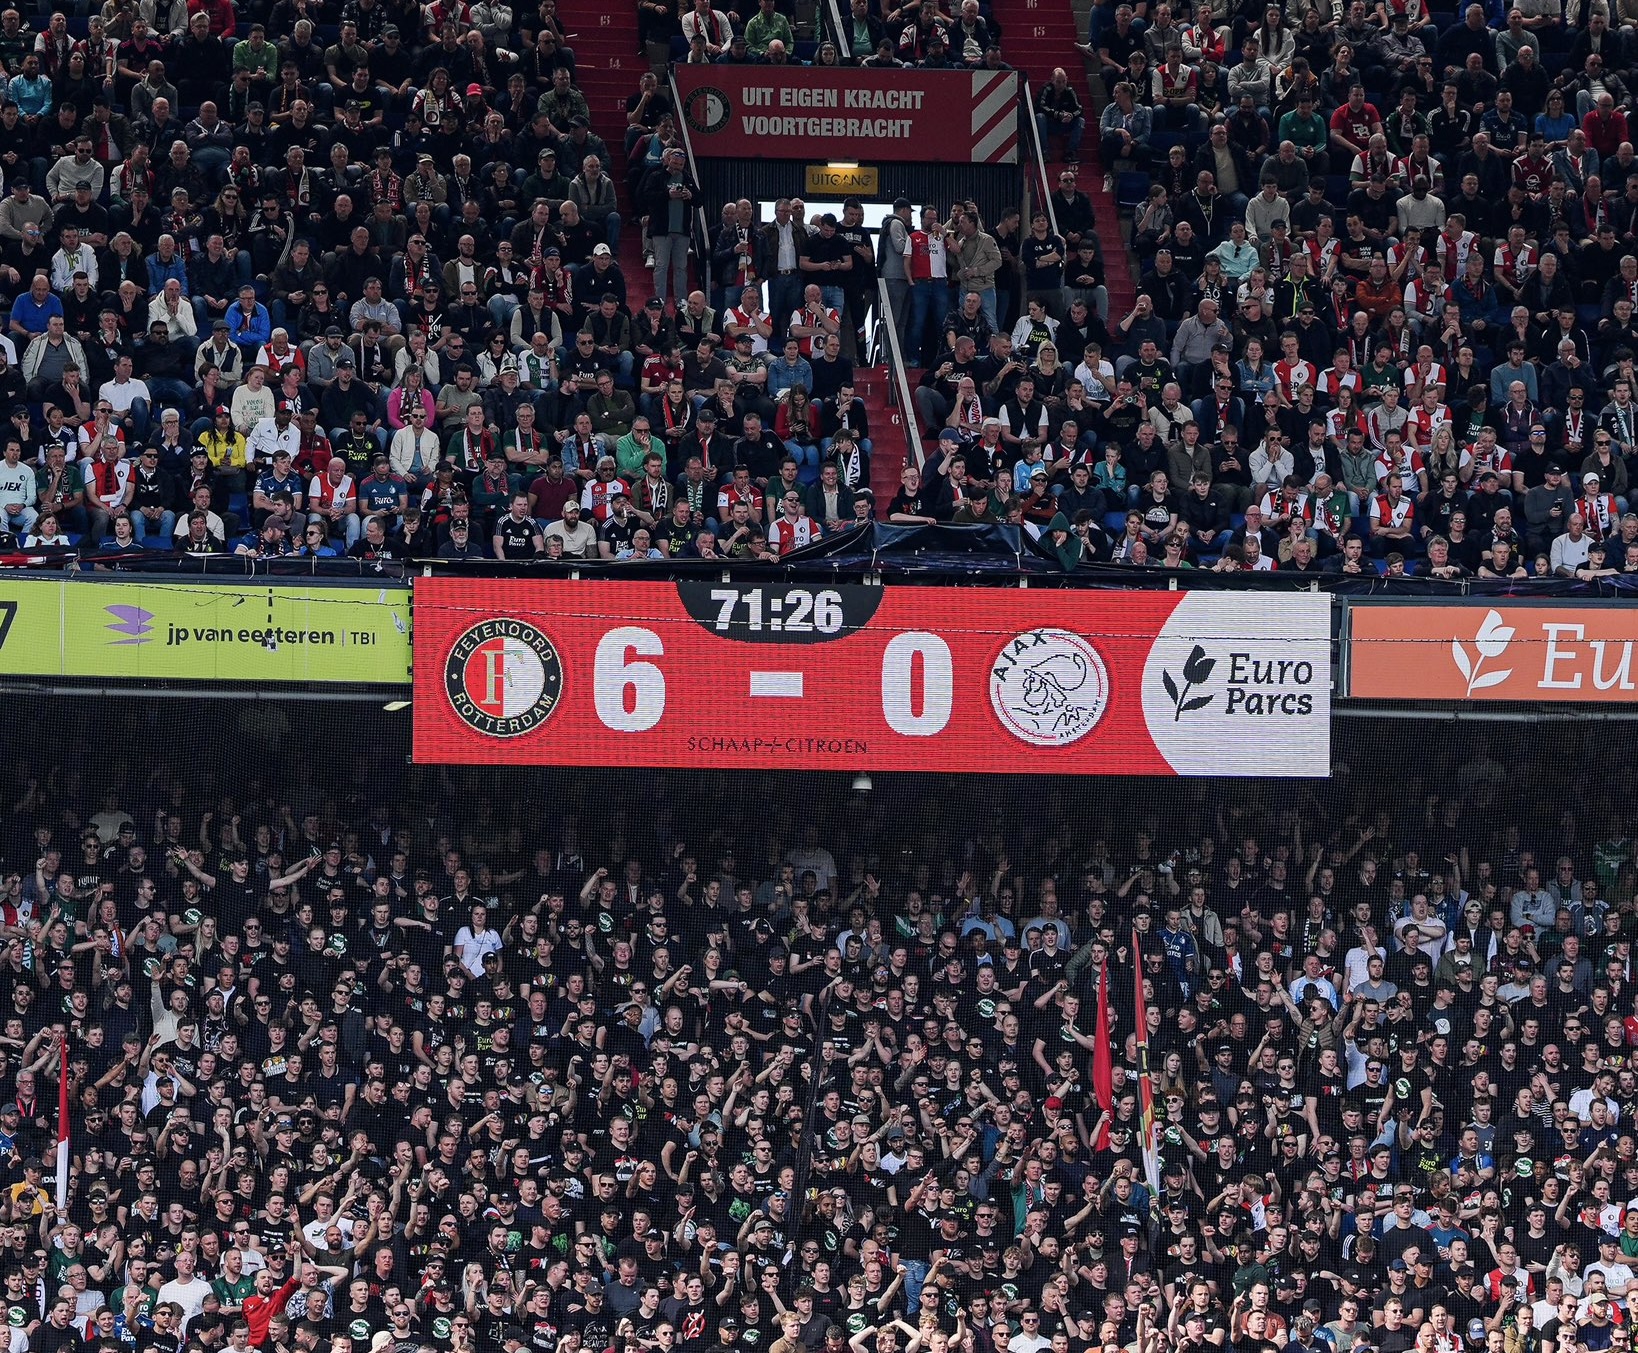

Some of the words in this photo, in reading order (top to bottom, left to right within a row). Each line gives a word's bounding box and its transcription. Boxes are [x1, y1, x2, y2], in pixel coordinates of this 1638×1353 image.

[742, 87, 774, 106] UIT
[780, 88, 838, 108] EIGEN
[844, 89, 925, 110] KRACHT
[741, 116, 913, 138] VOORTGEBRACHT
[812, 173, 872, 187] UITGANG
[891, 413, 901, 425] 6
[710, 588, 844, 634] 71:26
[166, 623, 190, 646] jp
[193, 627, 234, 643] van
[350, 632, 377, 646] TBI
[453, 622, 553, 662] FEYENOORD
[593, 626, 666, 732] 6
[880, 631, 954, 737] 0
[1227, 652, 1314, 685] Euro
[453, 692, 554, 733] ROTTERDAM
[1225, 687, 1313, 716] Parcs
